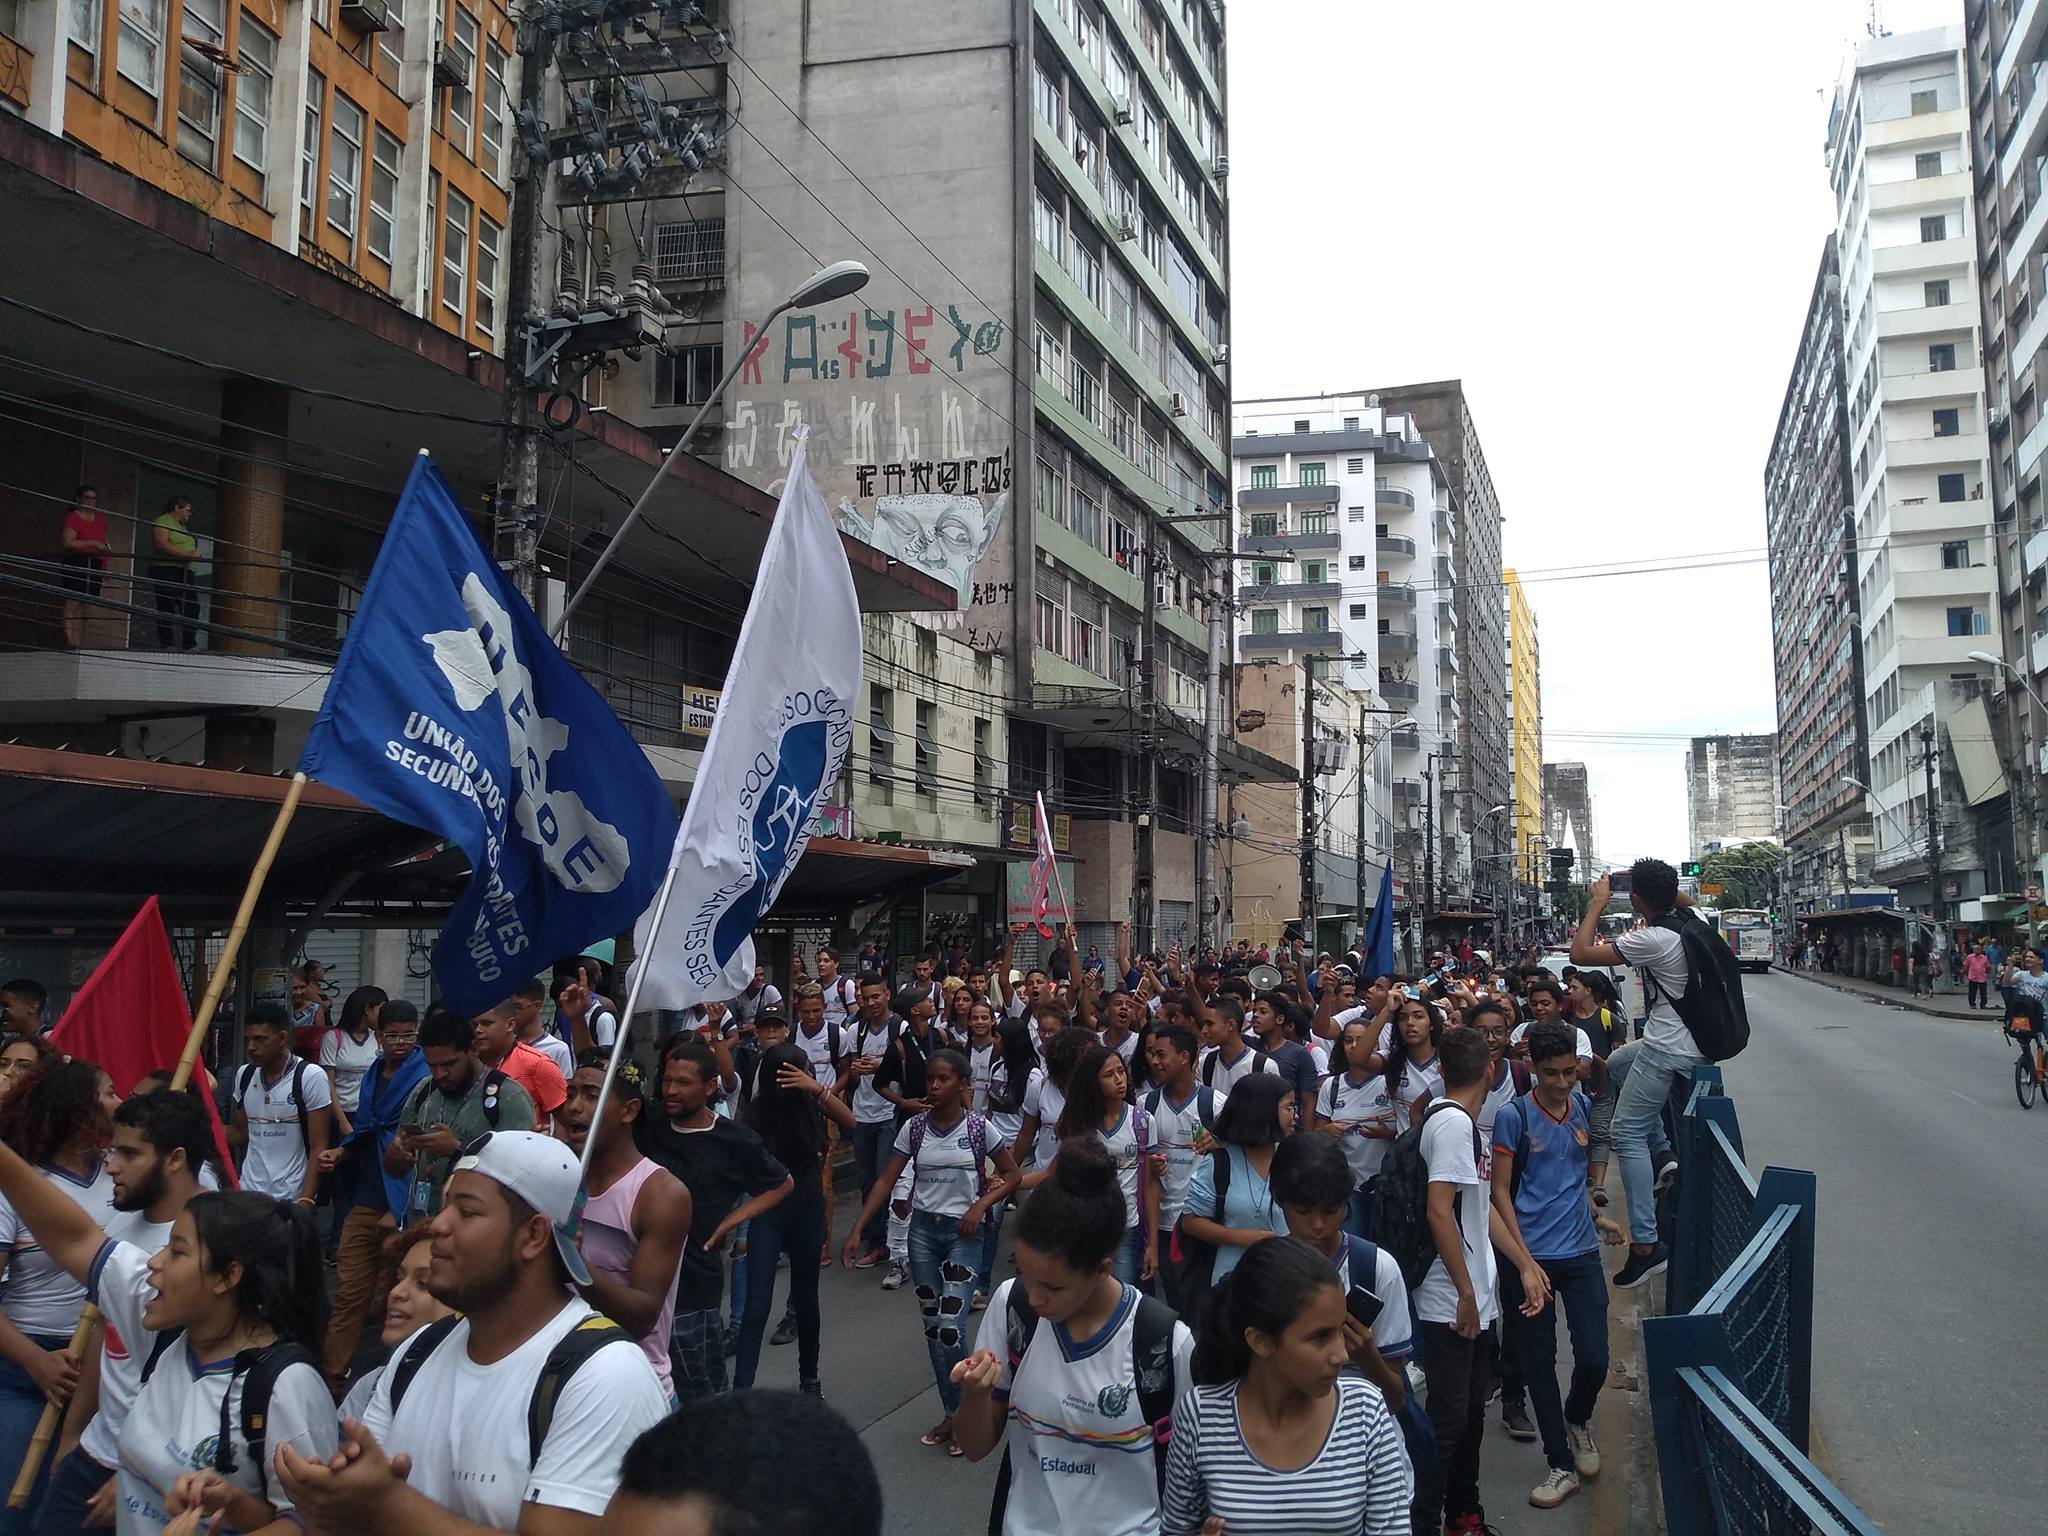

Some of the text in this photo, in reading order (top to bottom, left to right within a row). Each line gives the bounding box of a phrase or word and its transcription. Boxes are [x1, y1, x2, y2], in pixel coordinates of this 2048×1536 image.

[404, 711, 478, 774] UNIÃO
[474, 768, 506, 822] DOS
[739, 751, 775, 811] DOS
[1041, 1457, 1096, 1476] Estadual
